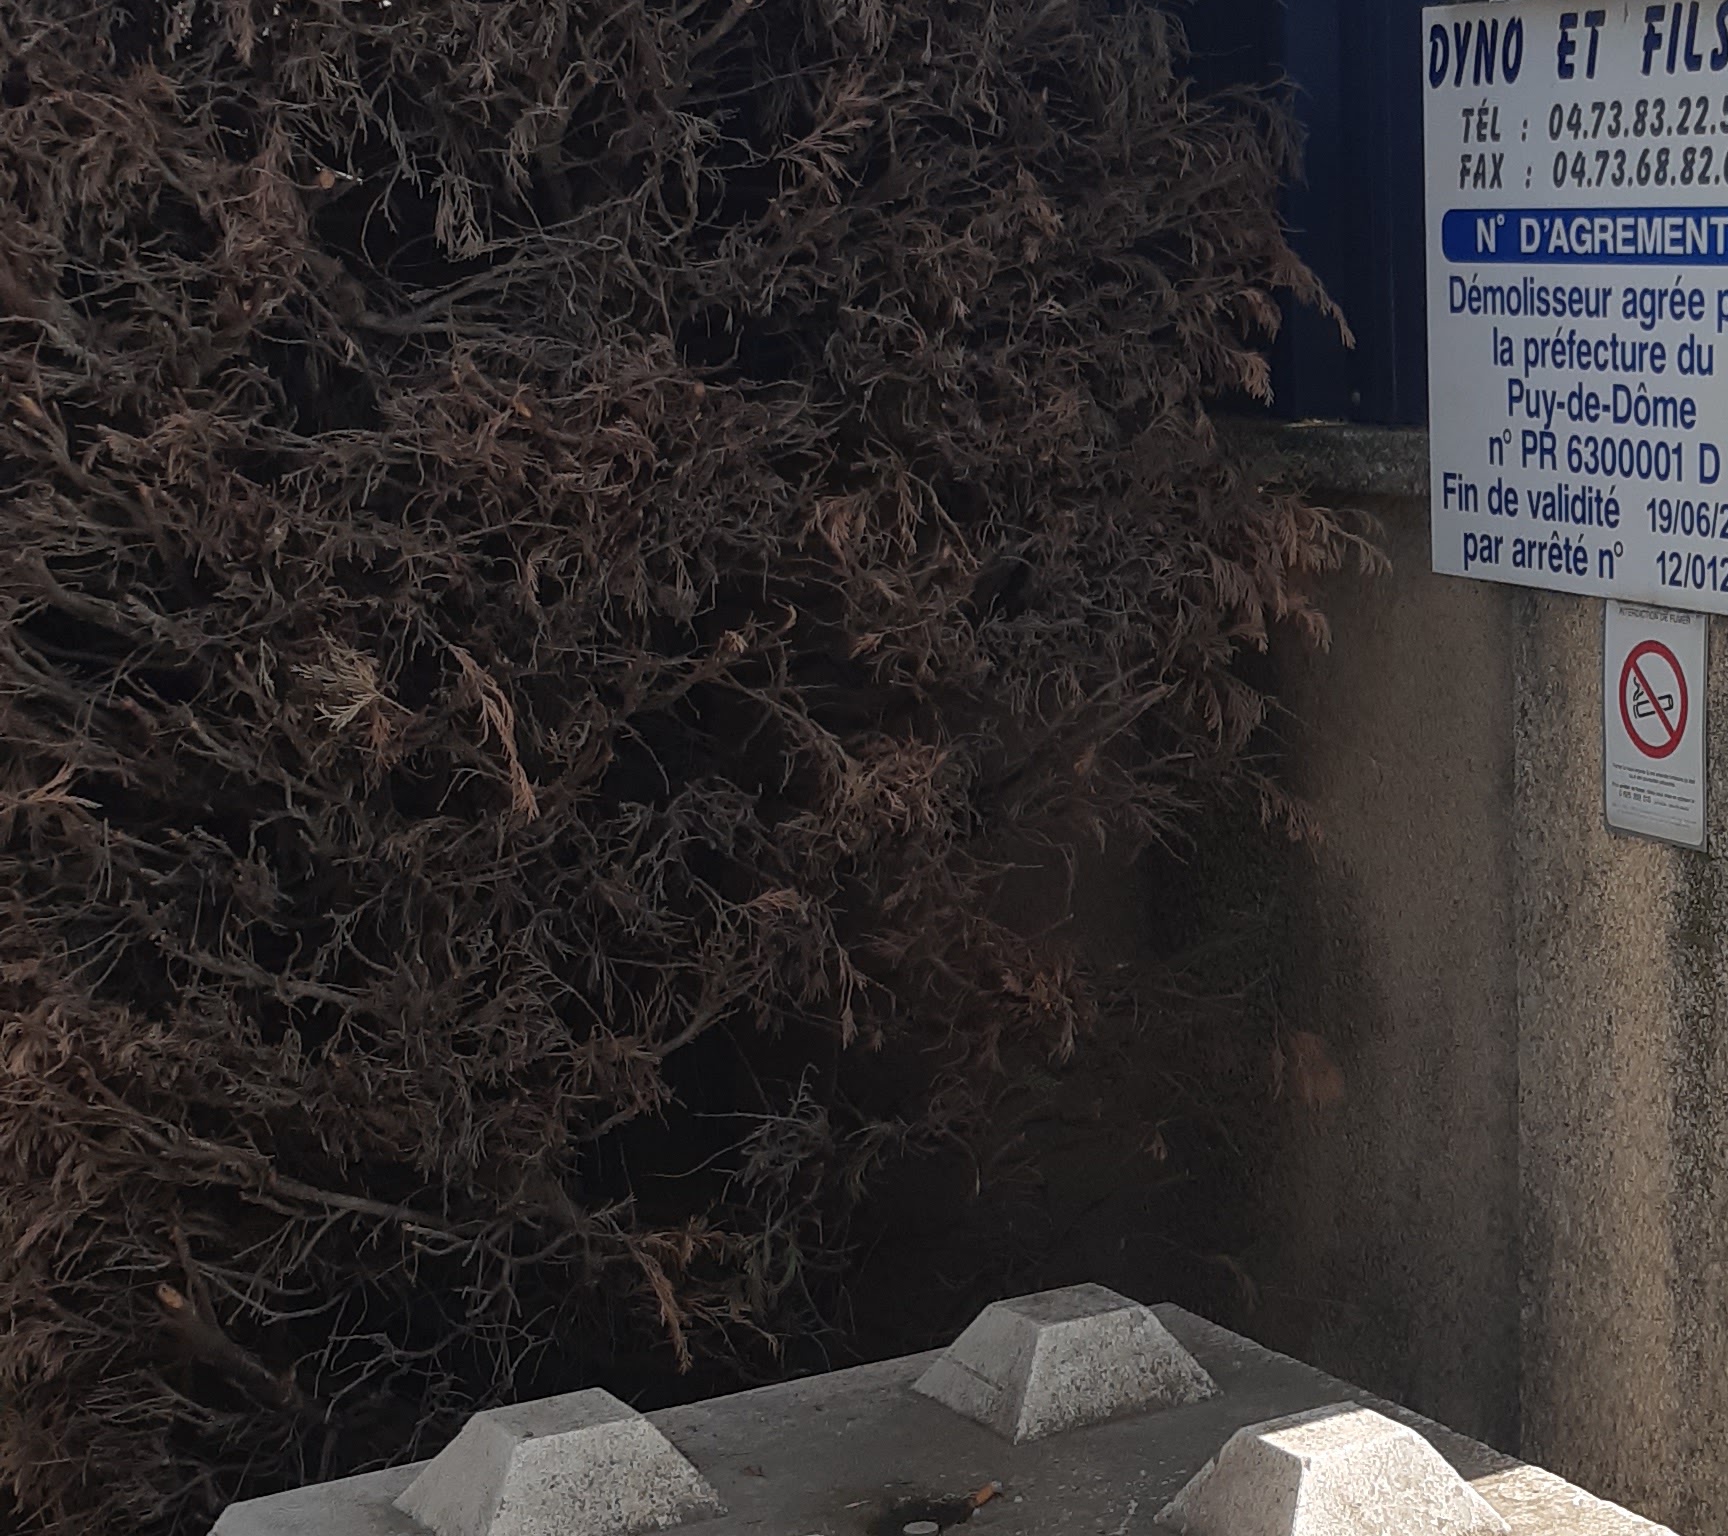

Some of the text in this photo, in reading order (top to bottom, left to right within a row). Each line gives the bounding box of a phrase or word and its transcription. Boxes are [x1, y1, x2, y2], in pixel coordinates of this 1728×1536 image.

[1428, 17, 1523, 89] DYNO
[1557, 10, 1606, 79] ET
[1461, 99, 1501, 143] TÉL
[1459, 153, 1504, 190] FAX
[1476, 215, 1504, 253] N°
[1449, 274, 1612, 318] Démolisseur
[1621, 276, 1705, 331] agrée
[1493, 326, 1714, 378] la préfecture du
[1507, 378, 1697, 430] Puy-de-Dôme
[1489, 428, 1721, 485] n° PR 6300001 D
[1443, 472, 1479, 513] Fin
[1488, 477, 1519, 517] de
[1527, 483, 1620, 529] validité
[1463, 531, 1503, 570] par
[1512, 531, 1588, 577] arrêté
[1599, 541, 1624, 579] n°
